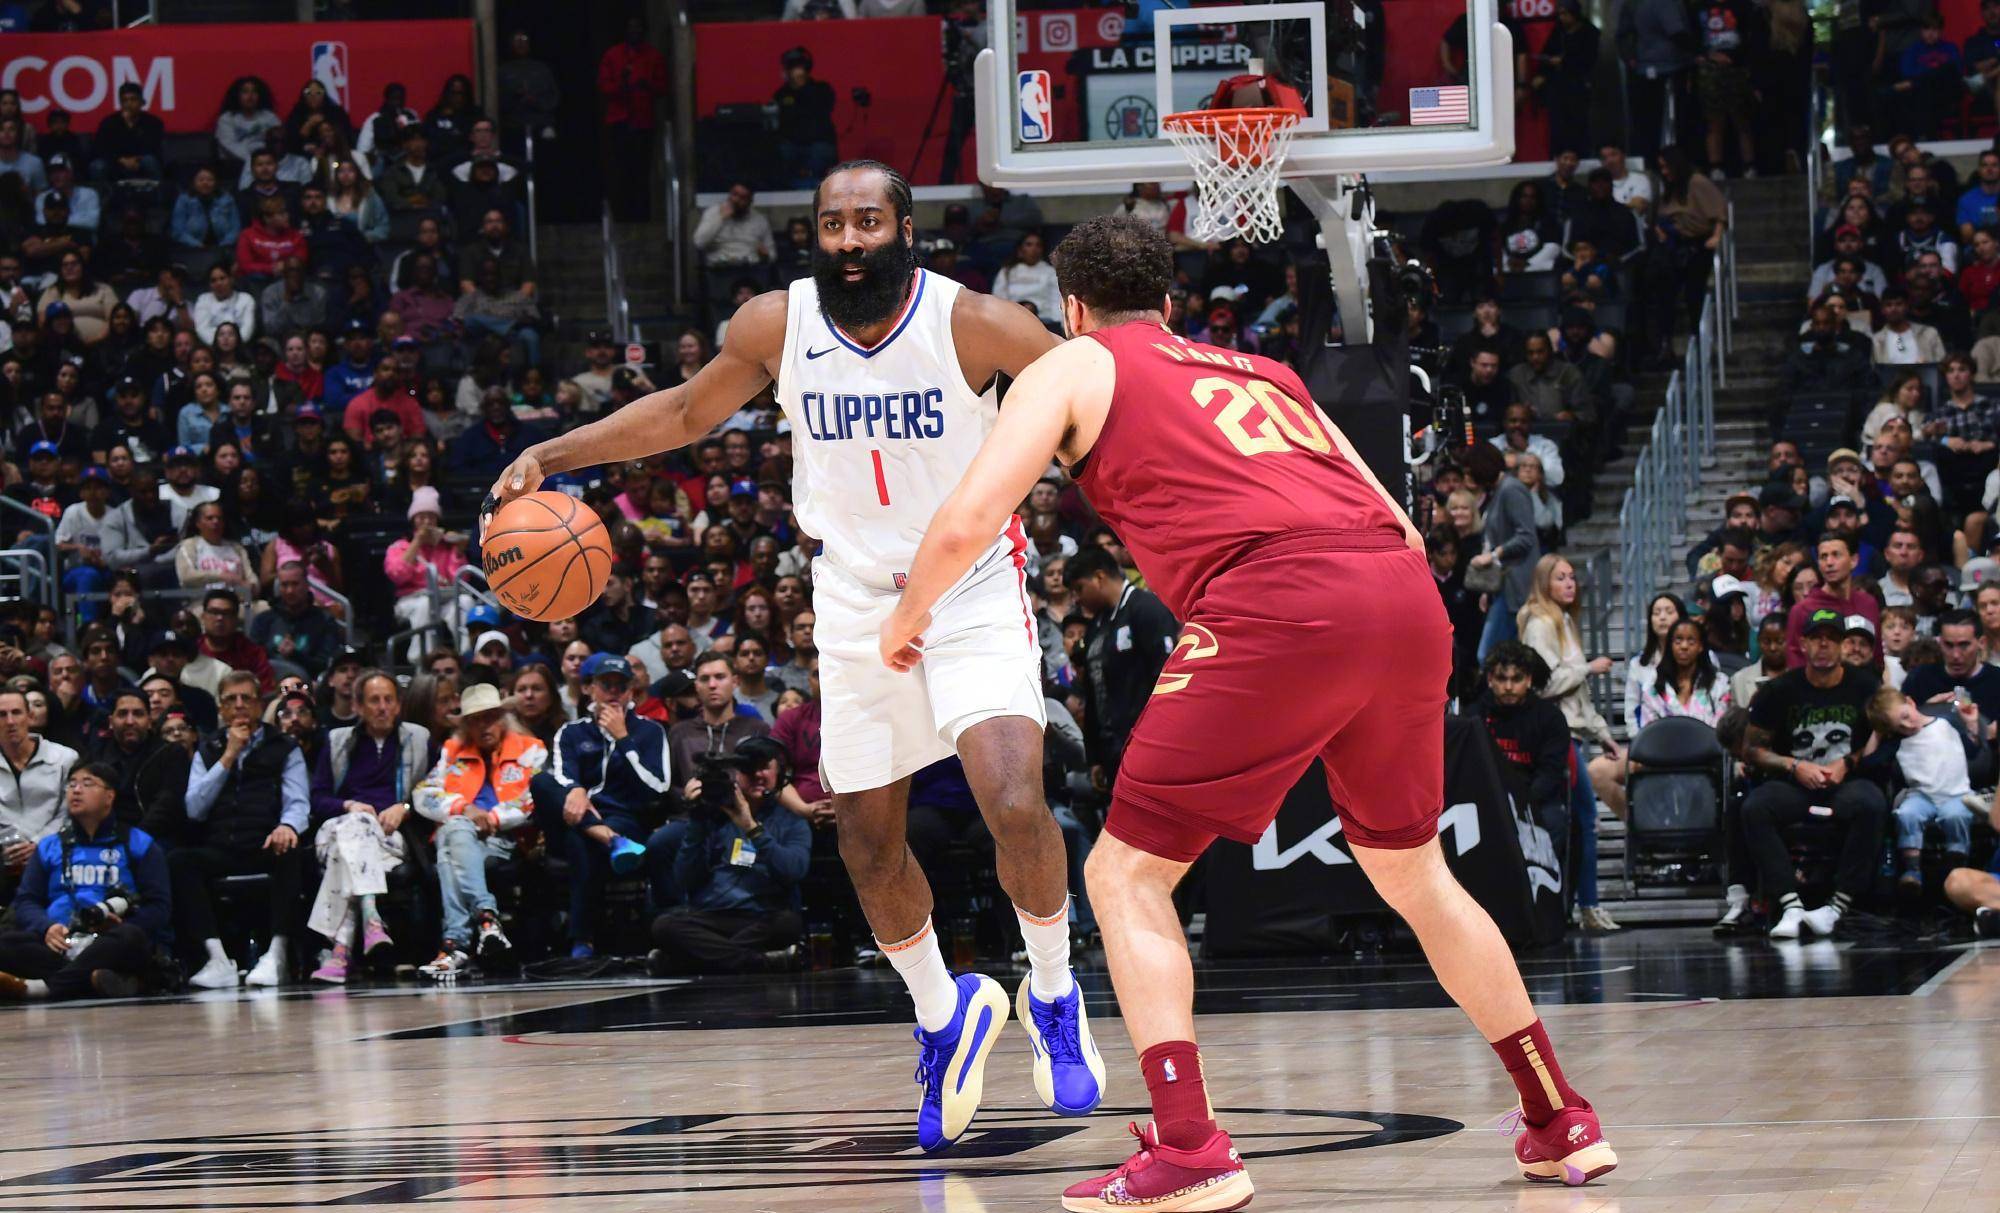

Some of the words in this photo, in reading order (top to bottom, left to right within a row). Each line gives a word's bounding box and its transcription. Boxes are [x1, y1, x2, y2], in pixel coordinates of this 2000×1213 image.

[1093, 48, 1129, 68] LA
[1135, 42, 1252, 68] CIPPER
[2, 55, 175, 113] COM
[801, 387, 944, 441] CLIPPERS
[1190, 377, 1331, 457] 20
[871, 449, 890, 506] 1
[61, 864, 119, 886] HOTO
